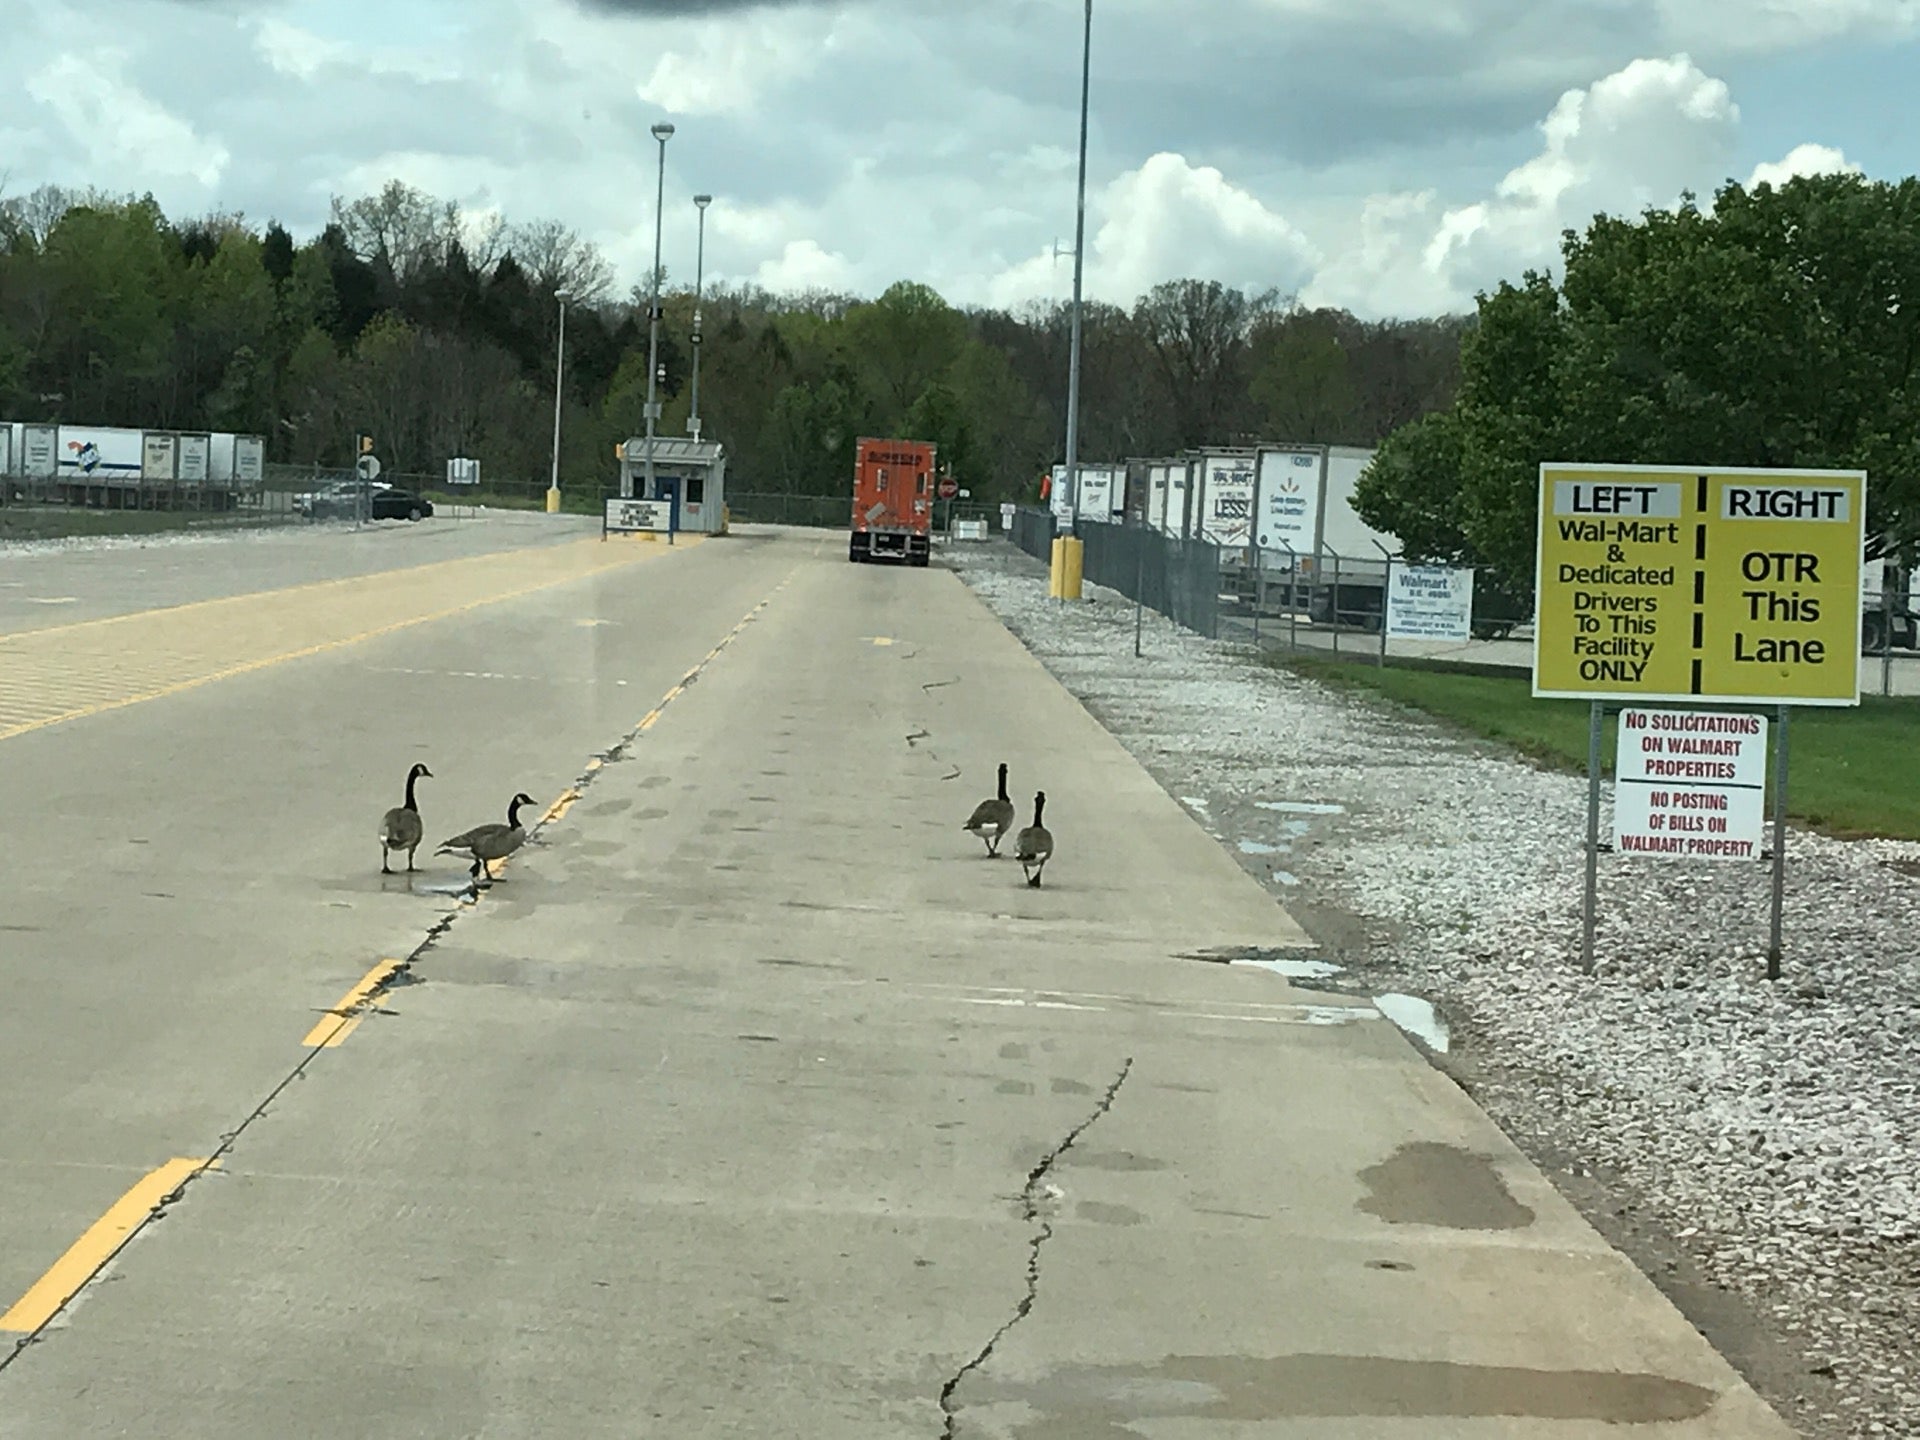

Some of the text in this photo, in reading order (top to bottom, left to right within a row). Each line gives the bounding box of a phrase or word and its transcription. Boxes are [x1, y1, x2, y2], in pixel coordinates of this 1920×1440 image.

[1573, 485, 1658, 514] LEFT
[1729, 489, 1844, 519] RIGHT
[1558, 520, 1679, 543] Wal-Mart
[1606, 544, 1625, 563] &
[1558, 564, 1675, 586] Dedicated
[1742, 552, 1821, 583] OTR
[1573, 592, 1658, 612] Drivers
[1742, 591, 1820, 622] This
[1574, 614, 1657, 635] To This
[1573, 636, 1654, 659] Facility
[1734, 633, 1825, 663] Lane
[1579, 660, 1648, 682] ONLY
[1625, 713, 1760, 735] NO SOLICITATIONS
[1642, 736, 1742, 756] ON WALMART
[1645, 759, 1736, 779] PROPERTIES
[1650, 791, 1728, 810] NO POSTING
[1649, 814, 1727, 833] OF BILLS ON
[1621, 834, 1754, 857] WALMART PROPERTY
